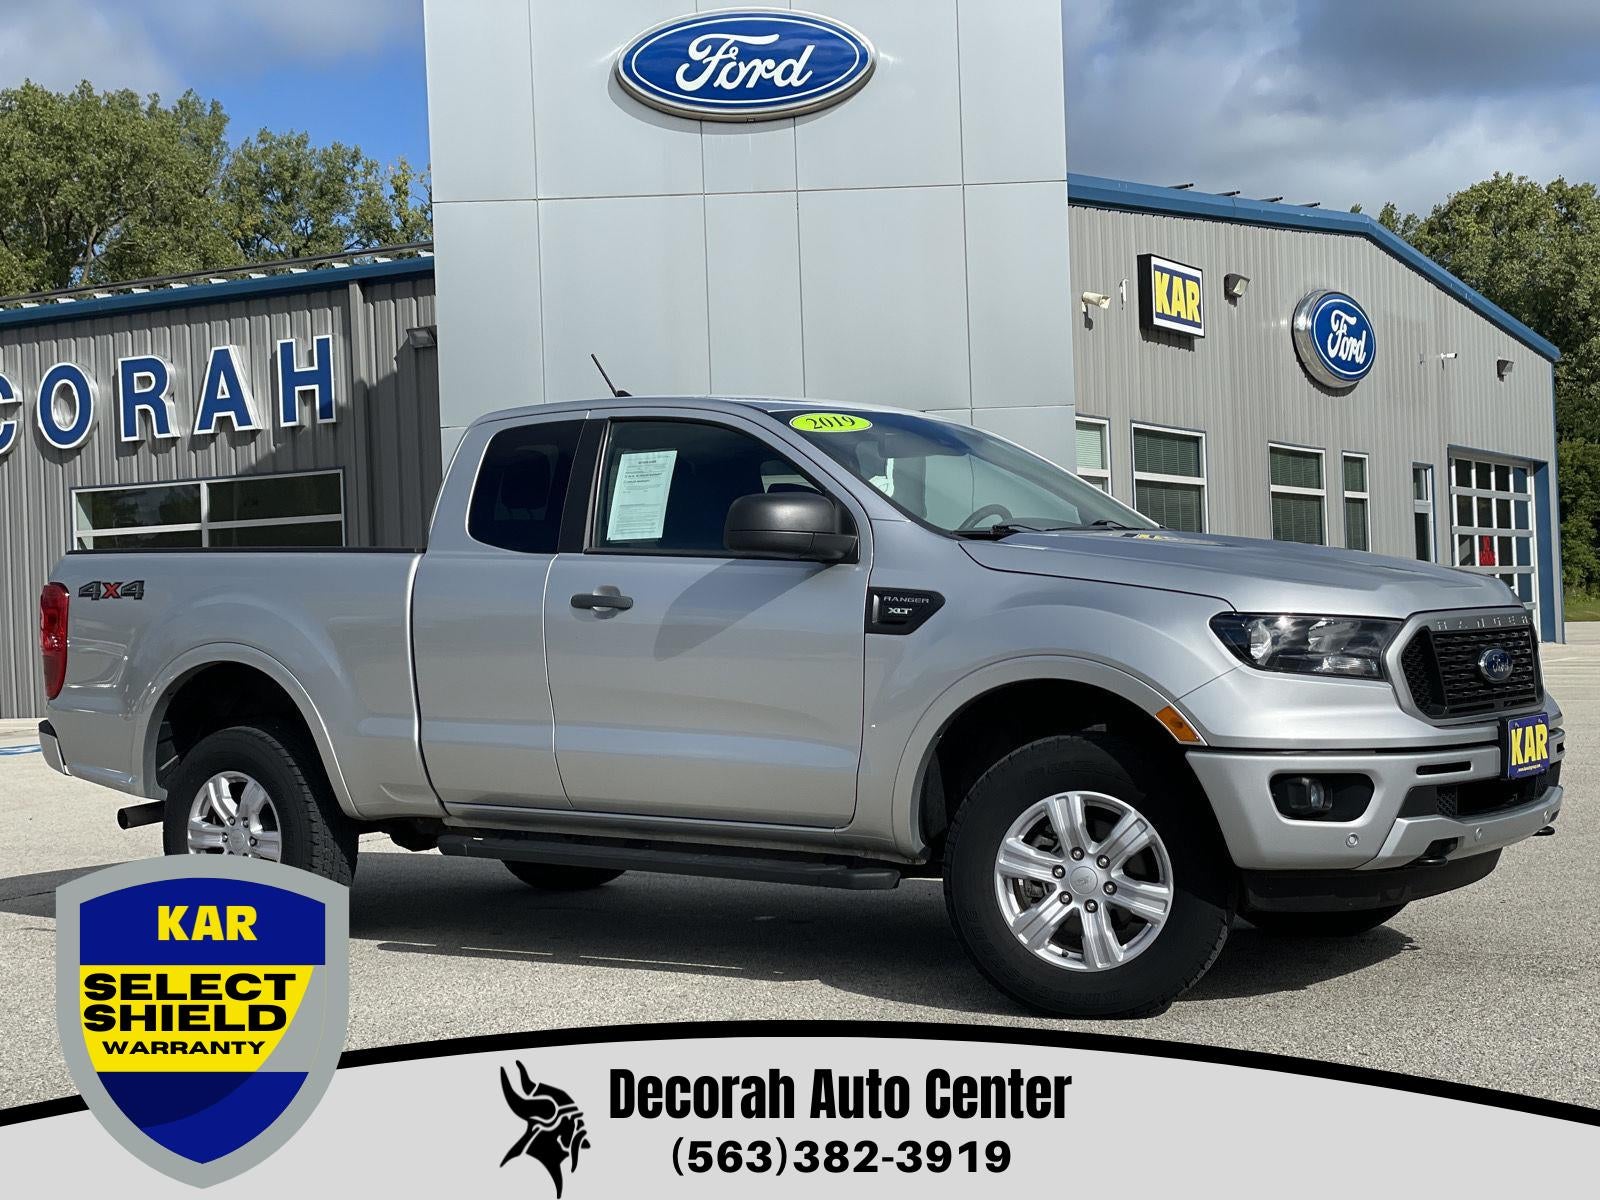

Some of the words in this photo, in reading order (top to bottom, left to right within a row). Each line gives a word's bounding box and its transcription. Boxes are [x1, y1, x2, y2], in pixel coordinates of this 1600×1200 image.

[675, 33, 816, 92] Ford
[1153, 270, 1201, 323] KAR
[1327, 309, 1367, 364] Ford
[805, 416, 856, 429] 2019
[883, 596, 930, 604] RANGER
[888, 607, 913, 615] XLT
[1511, 723, 1549, 766] KAR
